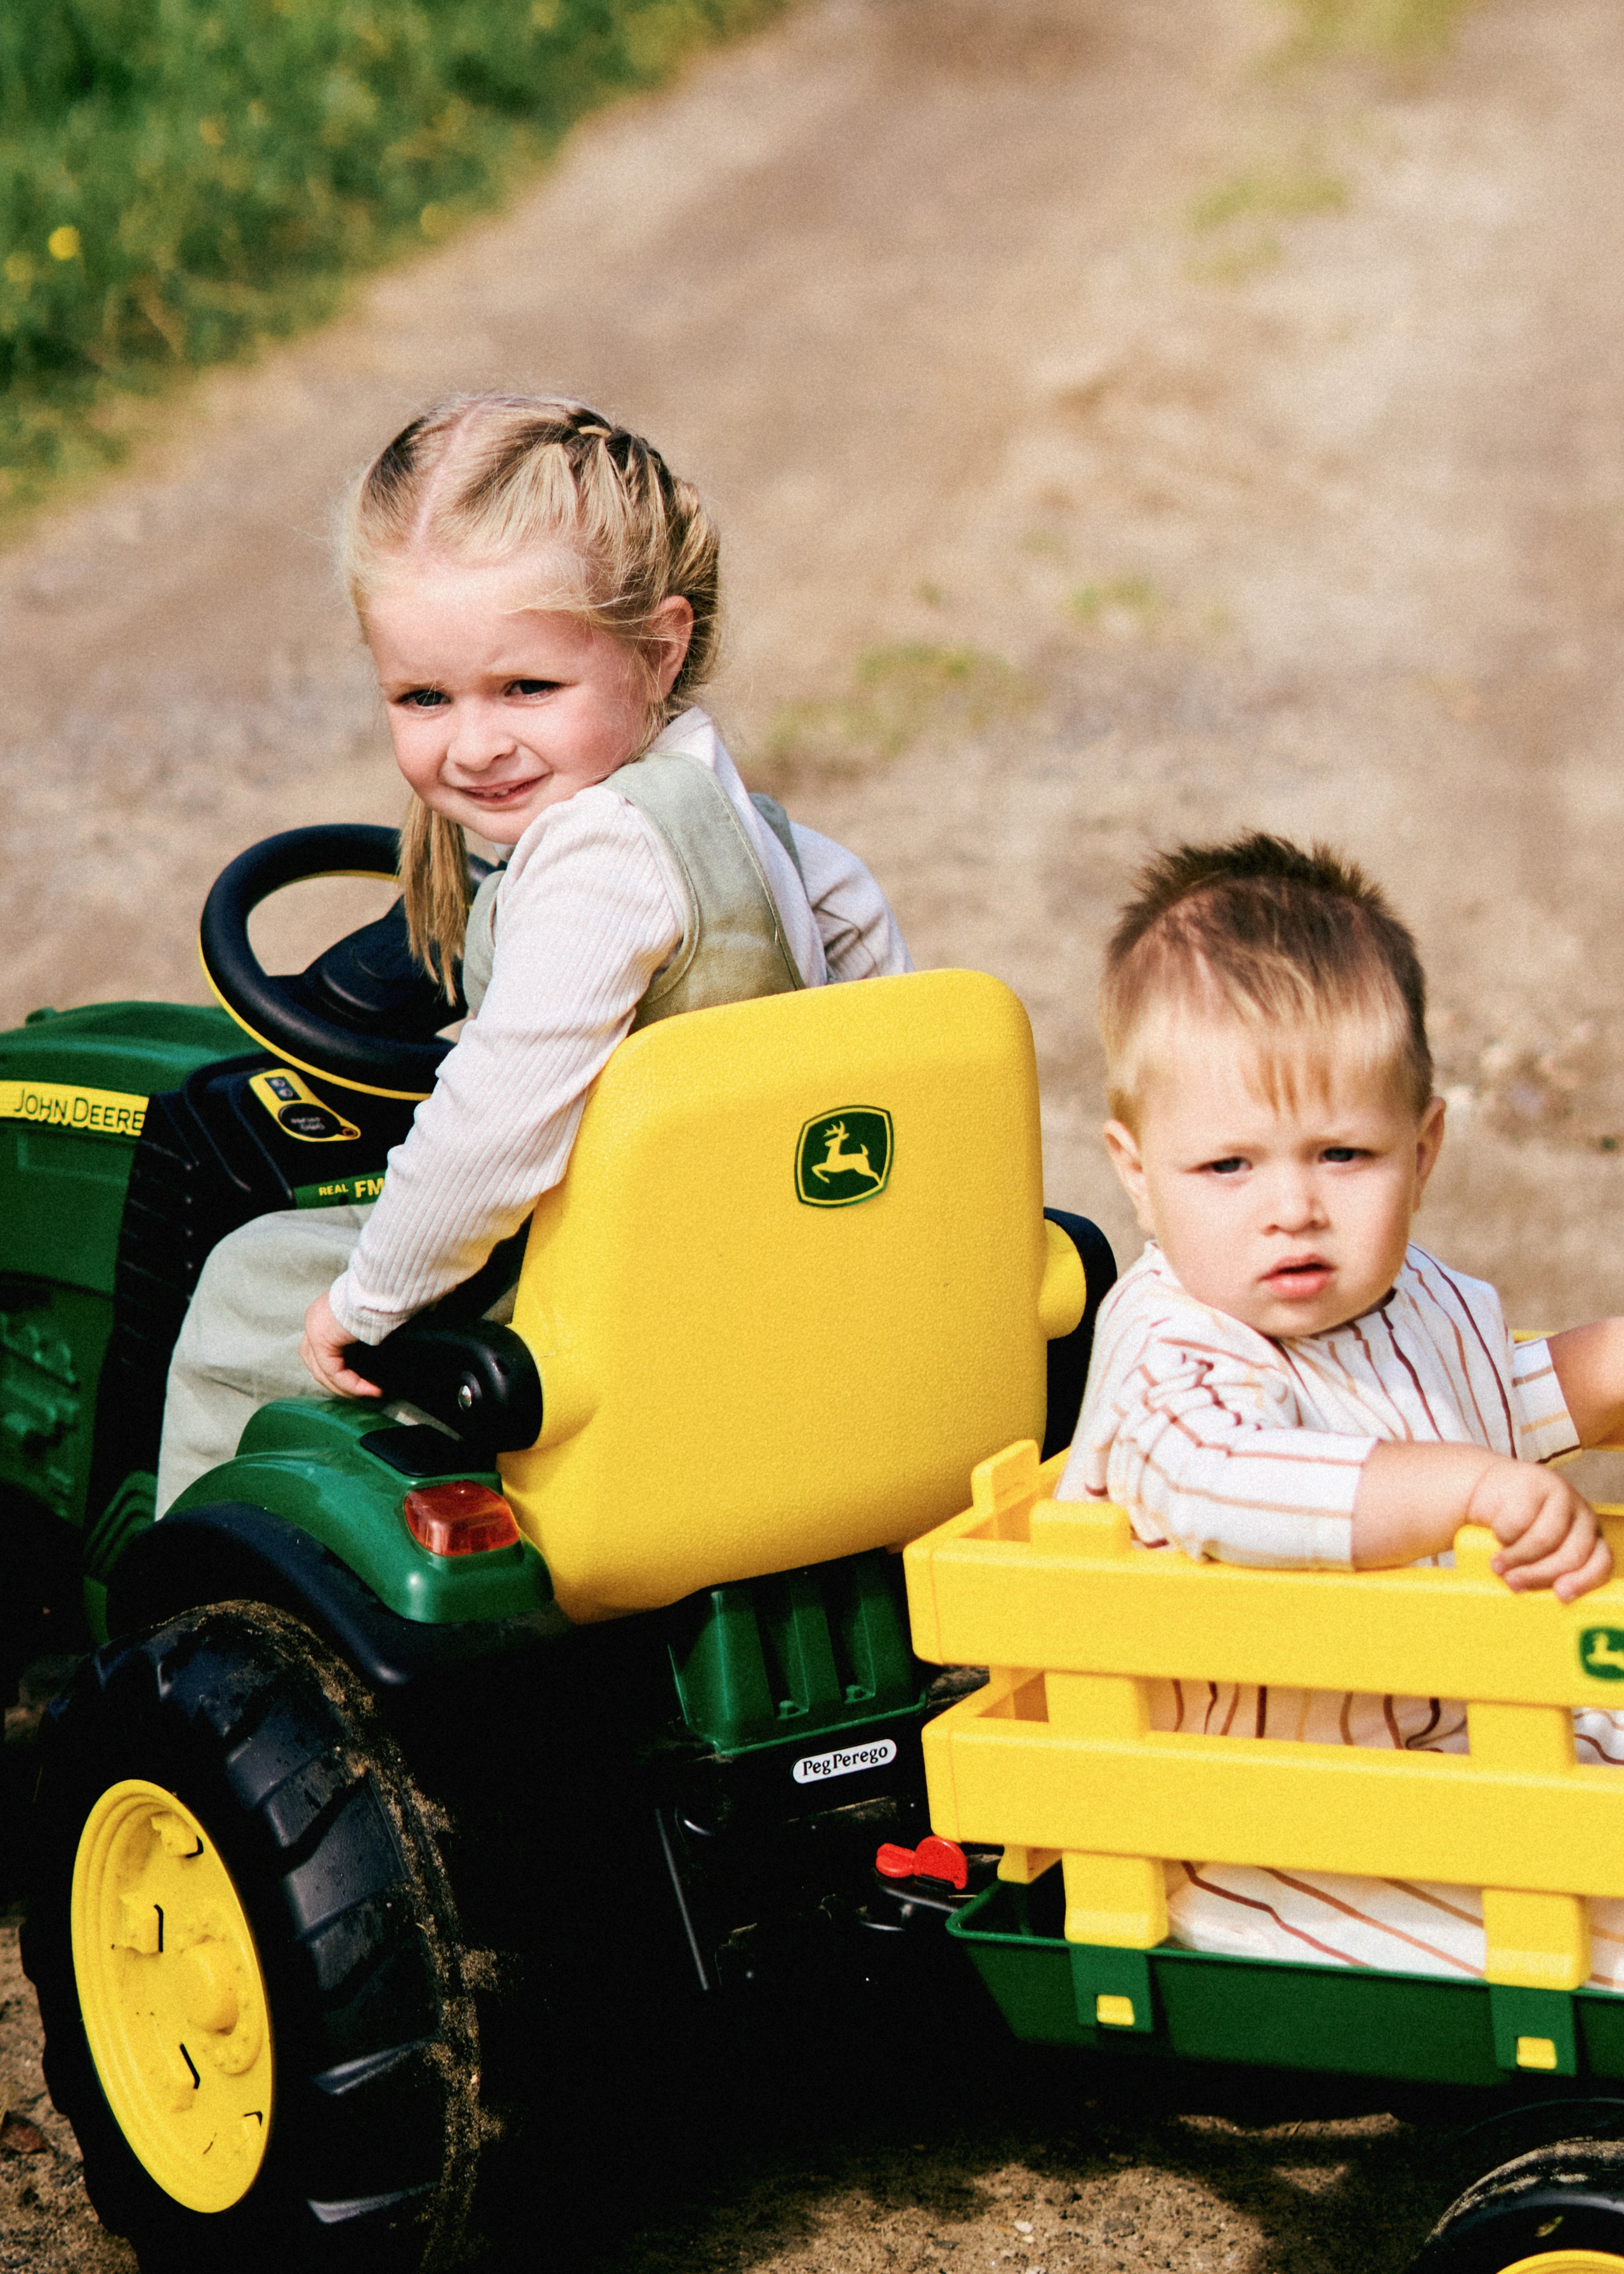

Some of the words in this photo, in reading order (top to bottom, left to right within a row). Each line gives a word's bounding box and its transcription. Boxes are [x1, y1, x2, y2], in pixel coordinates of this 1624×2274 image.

[13, 1088, 68, 1121] JOHN
[72, 1096, 146, 1131] DEERE
[318, 1183, 349, 1196] REAL
[355, 1177, 385, 1198] FM
